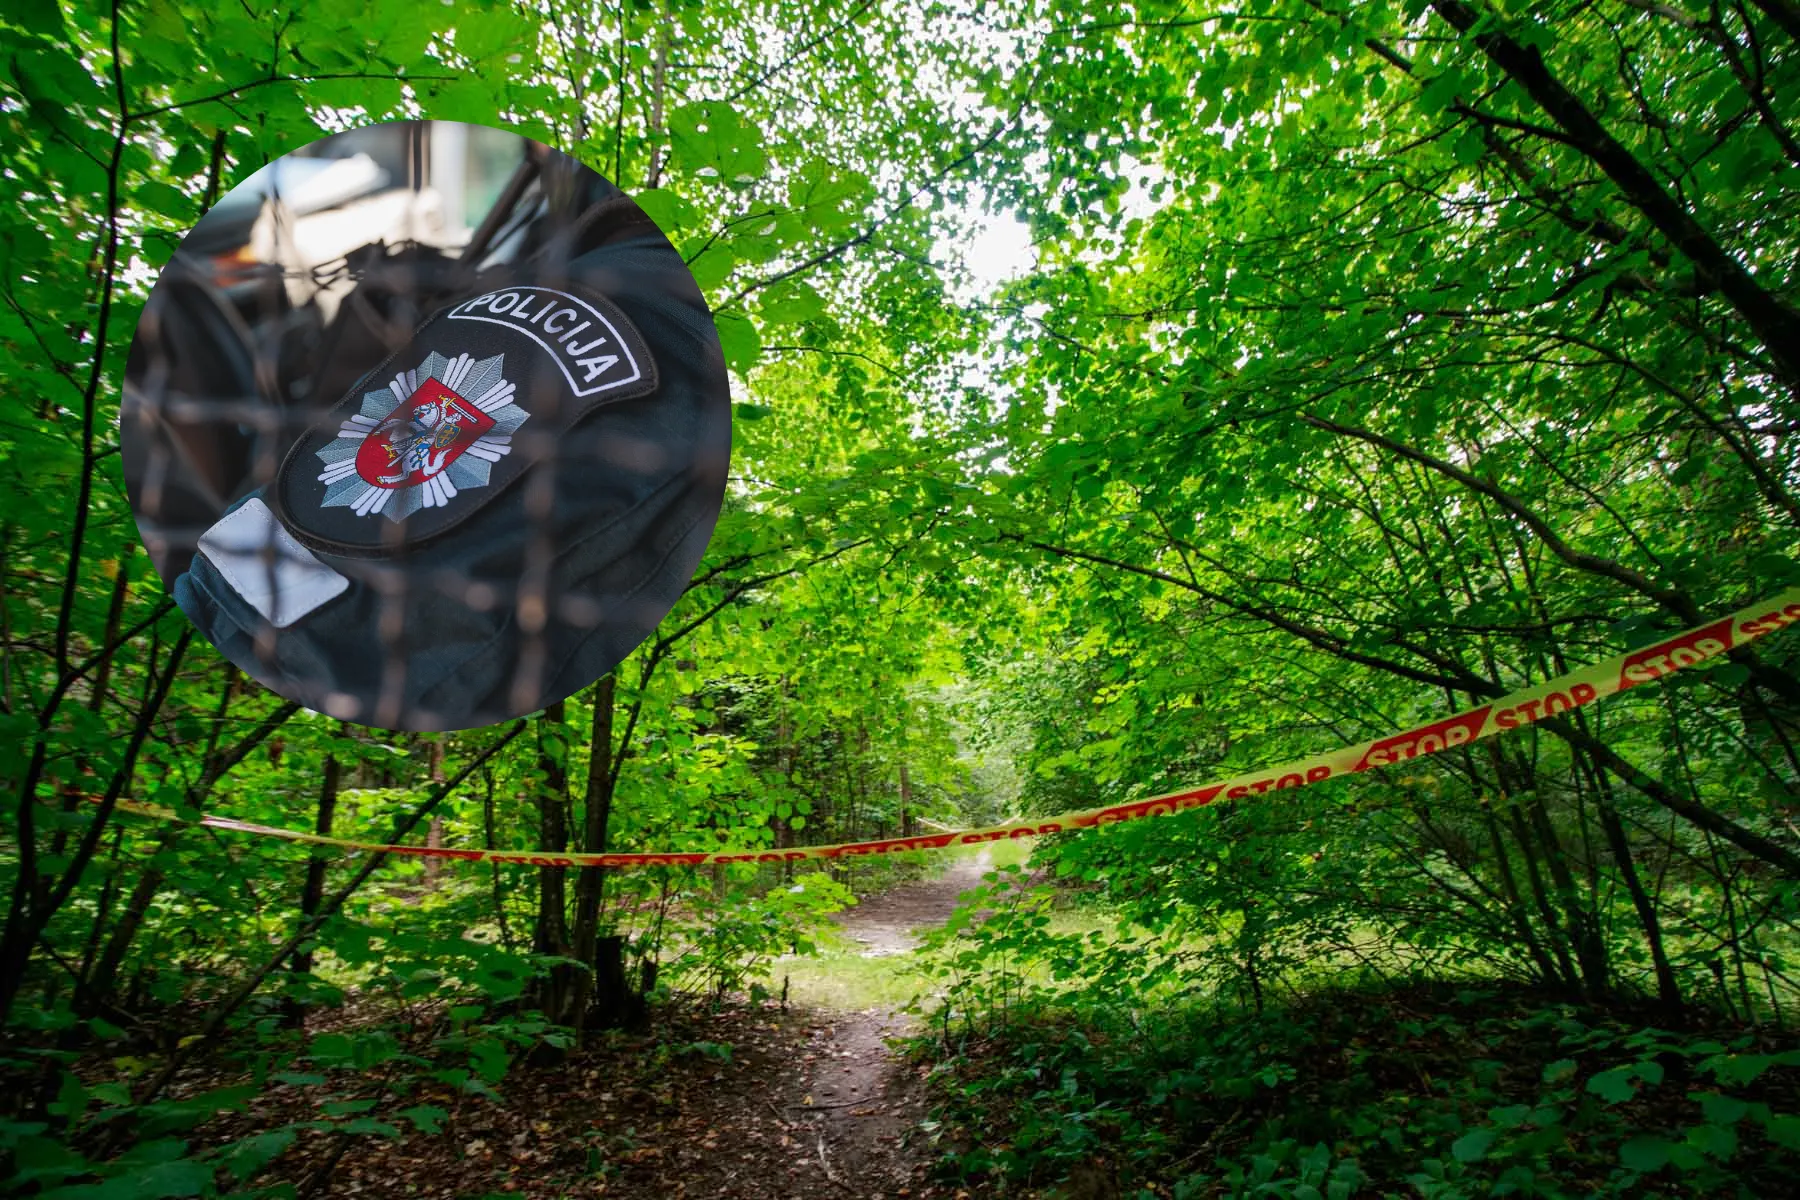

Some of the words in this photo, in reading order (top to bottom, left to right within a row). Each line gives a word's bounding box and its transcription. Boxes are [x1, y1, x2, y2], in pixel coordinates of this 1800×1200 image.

[466, 292, 619, 383] POLICIJA
[1366, 725, 1472, 767] STOP
[1495, 683, 1597, 729] STOP
[1624, 638, 1726, 681] STOP
